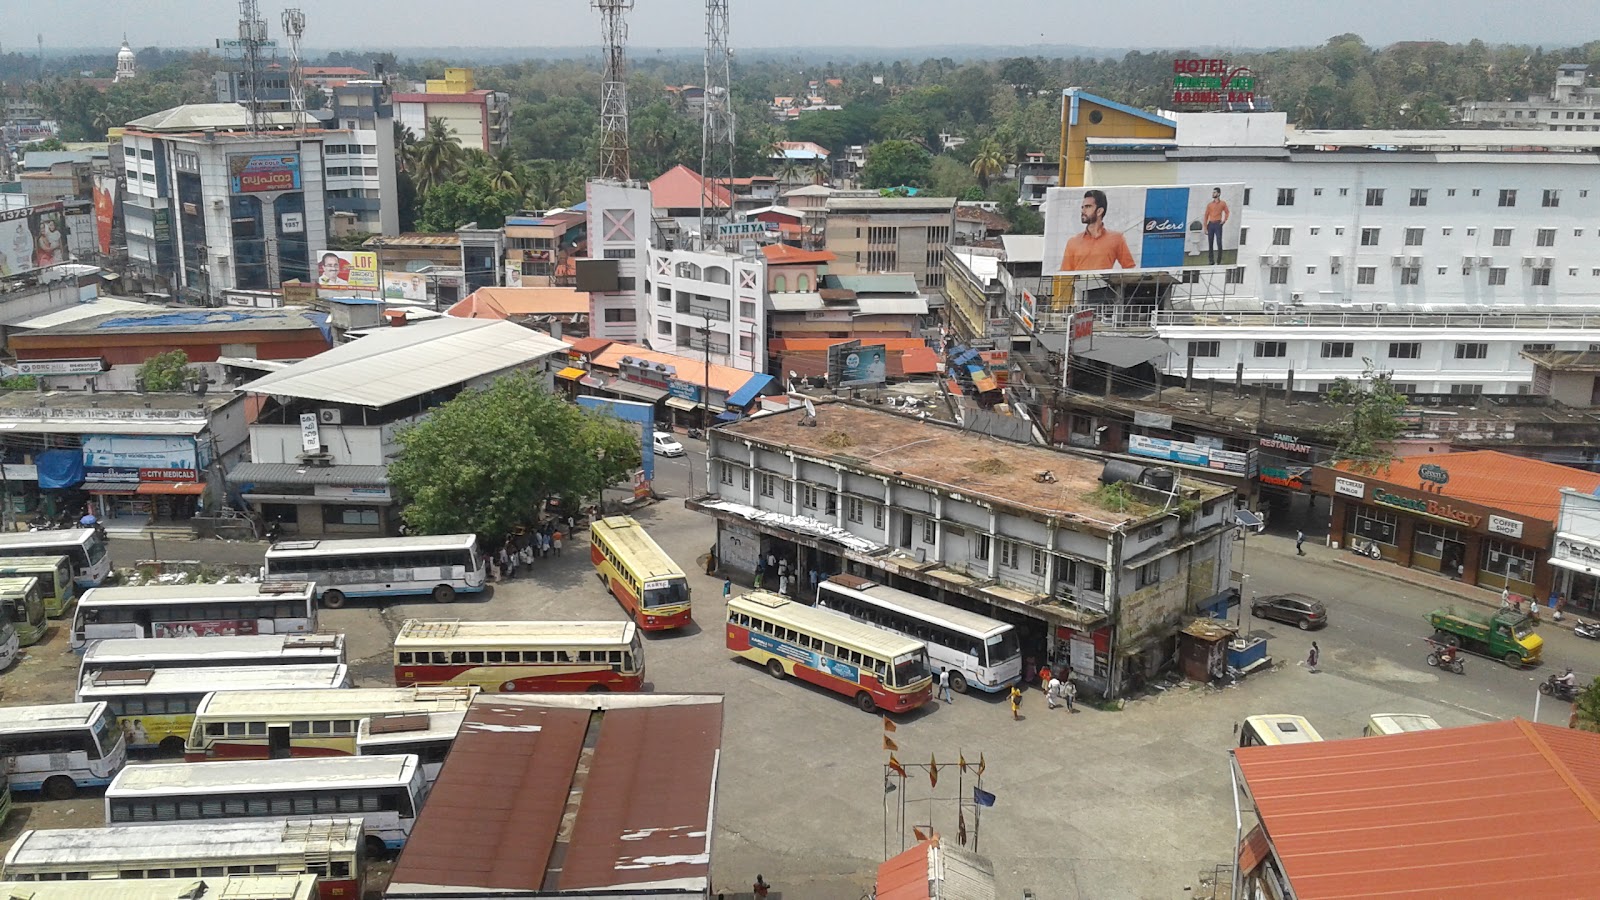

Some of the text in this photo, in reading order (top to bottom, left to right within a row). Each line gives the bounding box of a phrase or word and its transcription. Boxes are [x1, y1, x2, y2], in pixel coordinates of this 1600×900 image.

[1174, 59, 1225, 72] HOTEL
[1173, 91, 1255, 103] ROOMS BAR
[720, 224, 764, 234] NITHYA
[354, 255, 372, 269] LDF
[1273, 433, 1299, 443] FAMILY
[1260, 438, 1310, 453] RESTAURANT
[163, 471, 195, 479] MEDICALS
[1421, 467, 1447, 479] Green's
[1340, 486, 1358, 495] PARLOR
[1345, 480, 1363, 489] CREAM
[1372, 487, 1482, 528] Green's Bakery
[1493, 518, 1518, 530] COFFEE
[1496, 525, 1515, 534] SHOP
